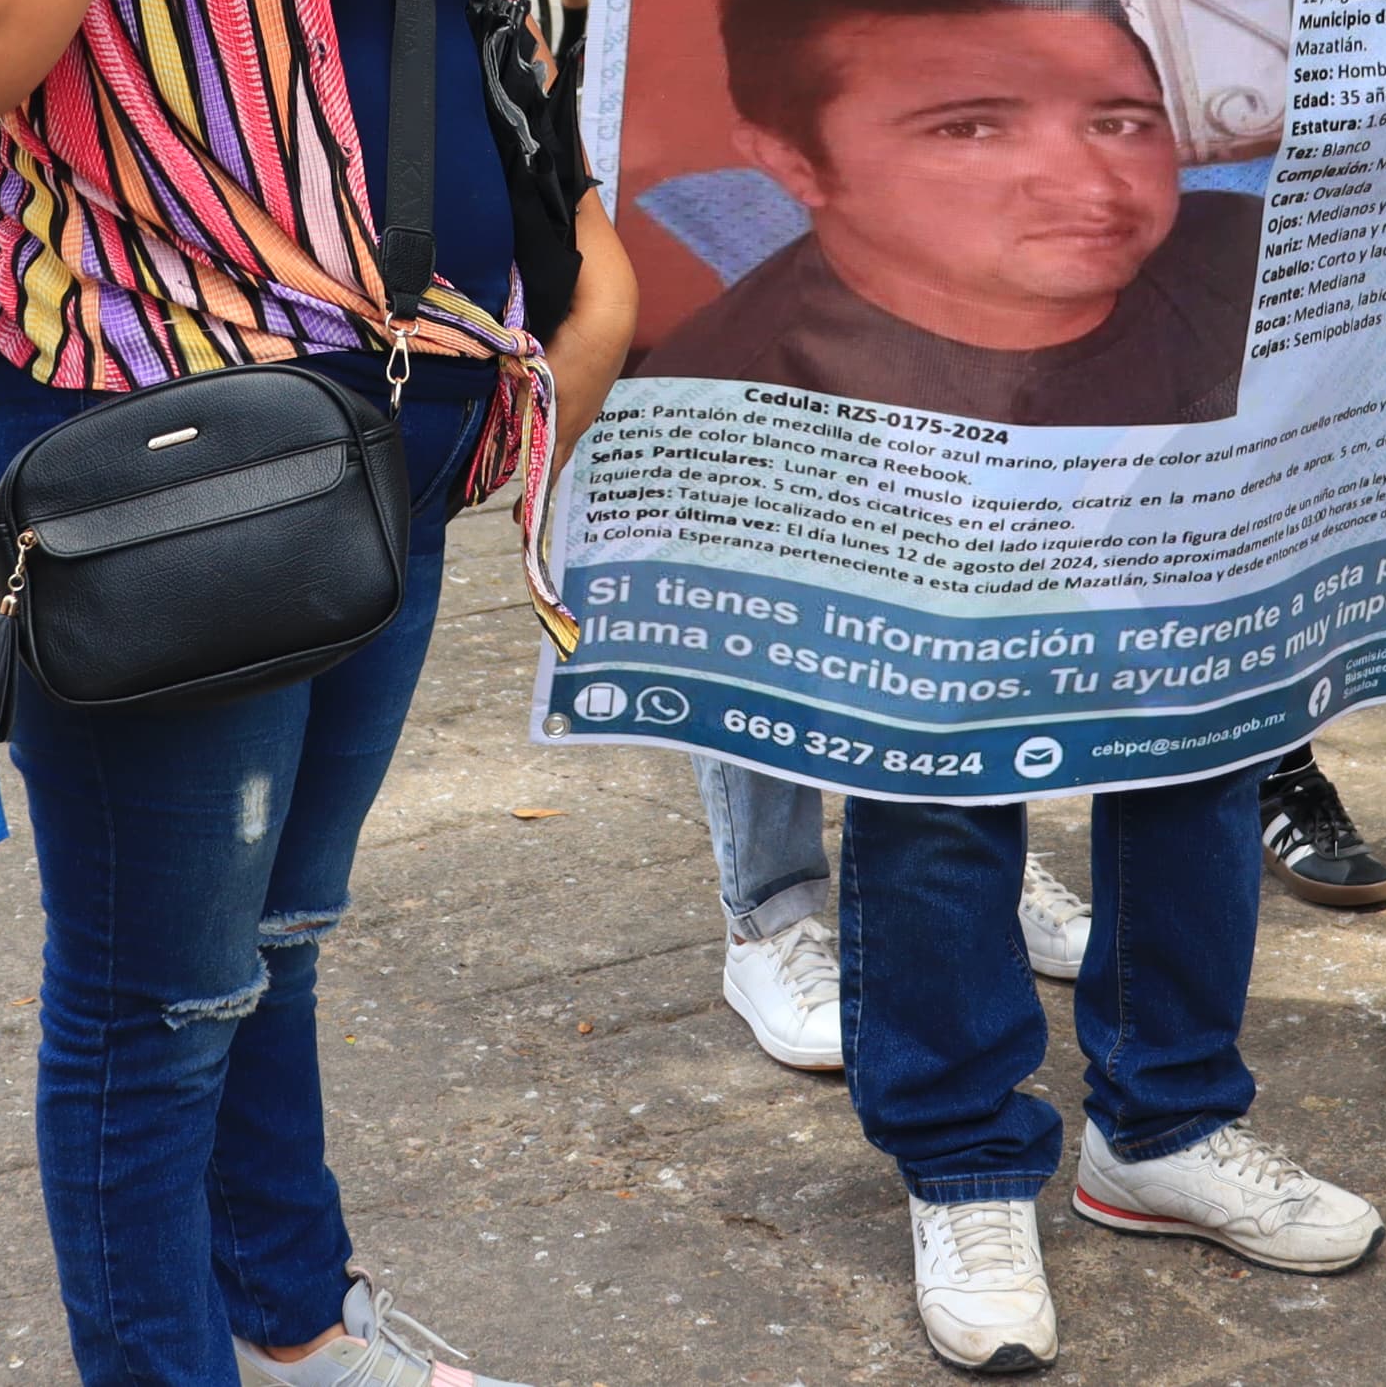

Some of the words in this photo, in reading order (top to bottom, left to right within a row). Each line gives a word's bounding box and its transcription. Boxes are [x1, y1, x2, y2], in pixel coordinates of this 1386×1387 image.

[1293, 64, 1334, 83] Sexo:
[1293, 90, 1336, 110] Edad:
[1340, 89, 1361, 105] 35
[745, 387, 830, 415] Cedula:
[837, 402, 1010, 446] RZS-0175-2024
[882, 457, 973, 487] Reebook.
[587, 574, 631, 605] Si
[656, 578, 800, 626] tienes
[823, 604, 1094, 663] información
[1117, 605, 1281, 653] referente
[1290, 592, 1304, 615] a
[1314, 564, 1364, 603] esta
[583, 616, 709, 651] llama
[724, 633, 753, 658] o
[767, 639, 1032, 704] escribenos.
[1050, 667, 1098, 695] Tu
[1112, 653, 1229, 697] ayuda
[1241, 642, 1277, 671] es
[1284, 613, 1332, 659] muy
[722, 708, 797, 749] 669
[803, 730, 874, 767] 327
[882, 749, 984, 778] 8424
[1091, 710, 1287, 759] cebpd@sinaloa.gob.mx
